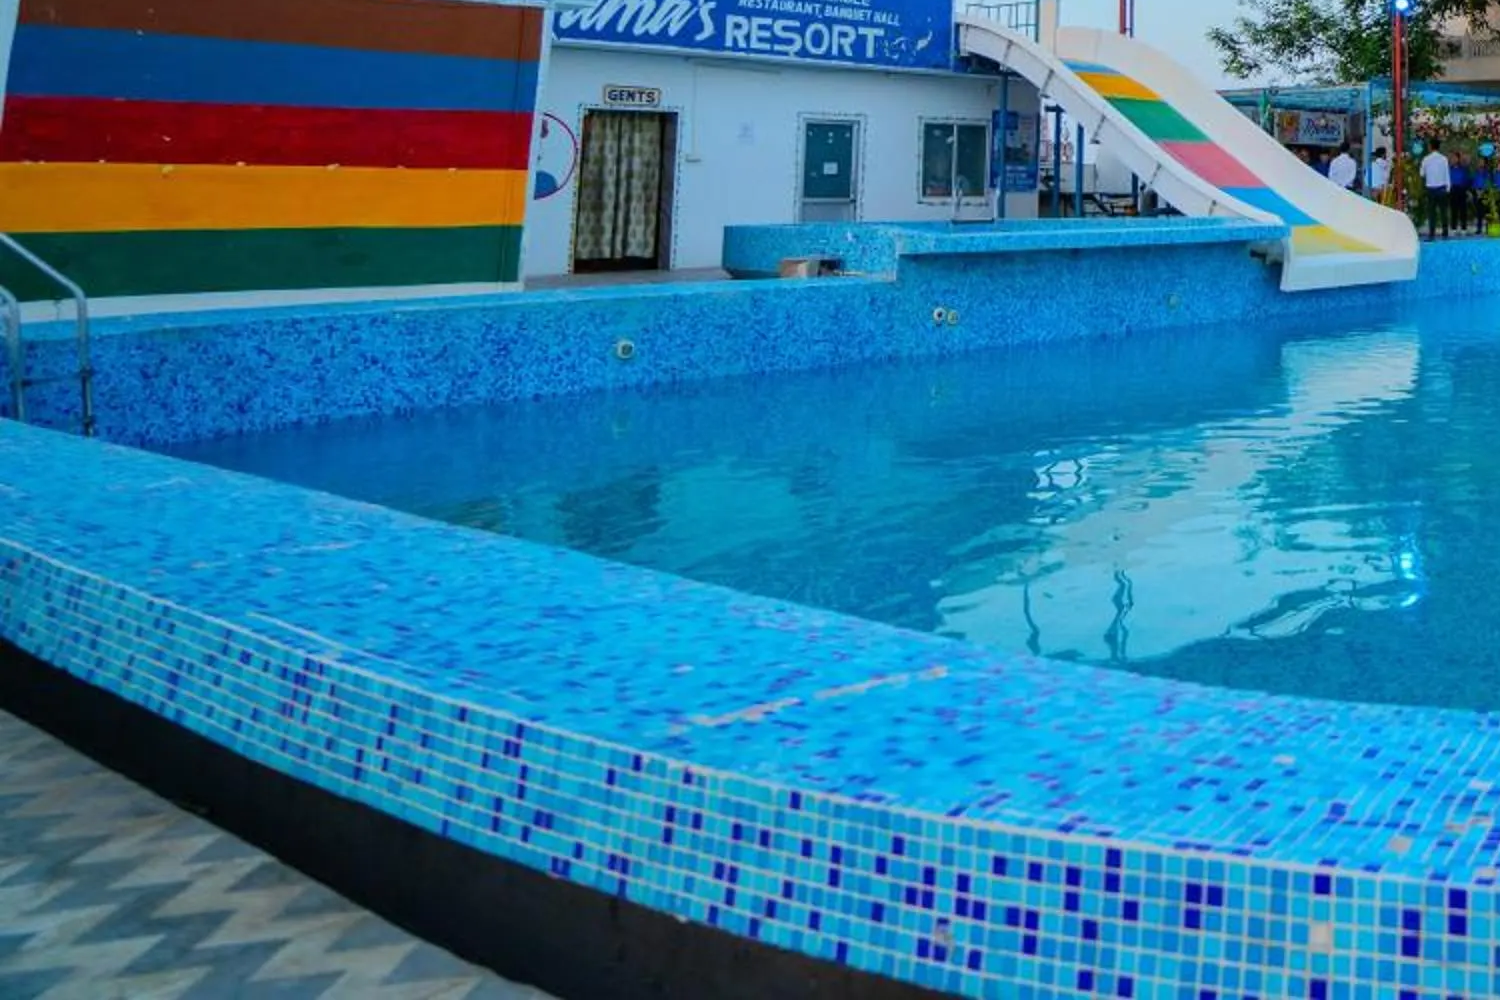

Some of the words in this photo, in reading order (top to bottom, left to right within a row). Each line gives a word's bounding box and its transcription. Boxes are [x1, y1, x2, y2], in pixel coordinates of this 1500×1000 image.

[824, 5, 873, 22] BANQUET
[873, 10, 901, 26] HALL
[724, 14, 885, 58] RESORT
[607, 89, 656, 103] GENTS
